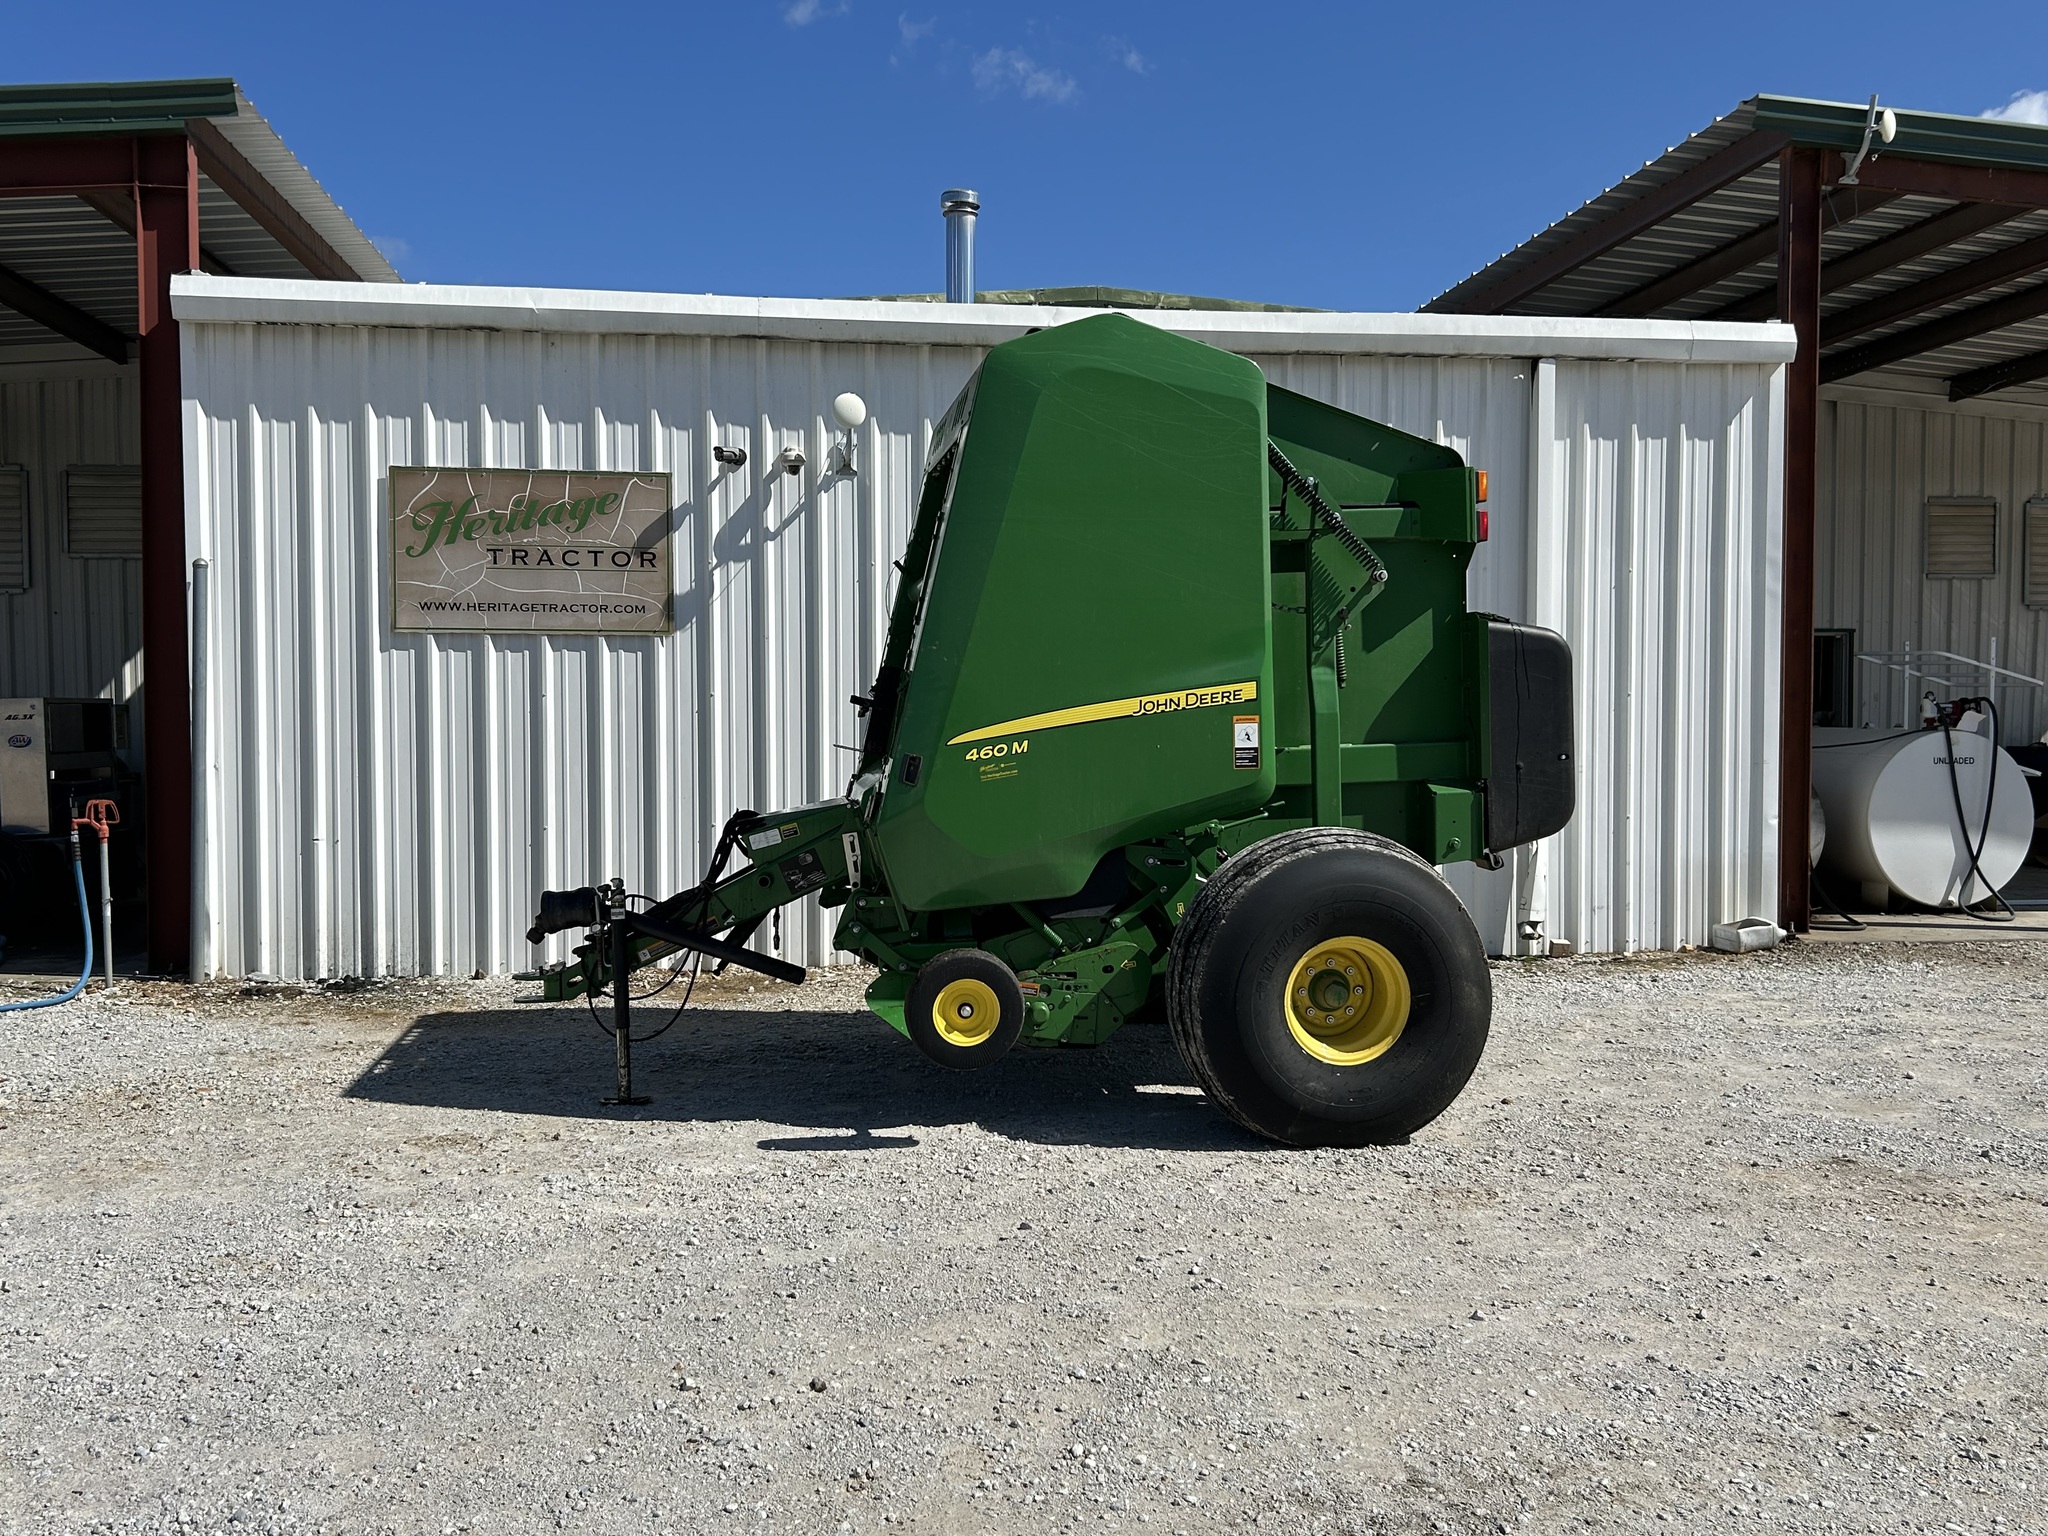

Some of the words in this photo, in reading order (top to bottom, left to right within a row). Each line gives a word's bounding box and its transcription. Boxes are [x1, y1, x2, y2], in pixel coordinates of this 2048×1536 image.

[405, 492, 619, 559] Heritage
[486, 548, 657, 568] TRACTOR
[418, 601, 646, 614] WWW.HERITAGETRACTOR.COM
[1132, 696, 1181, 715] JOHN
[1185, 689, 1243, 708] DEERE
[965, 743, 1008, 761] 460
[1011, 739, 1029, 755] M
[1933, 757, 1975, 765] UNLADED
